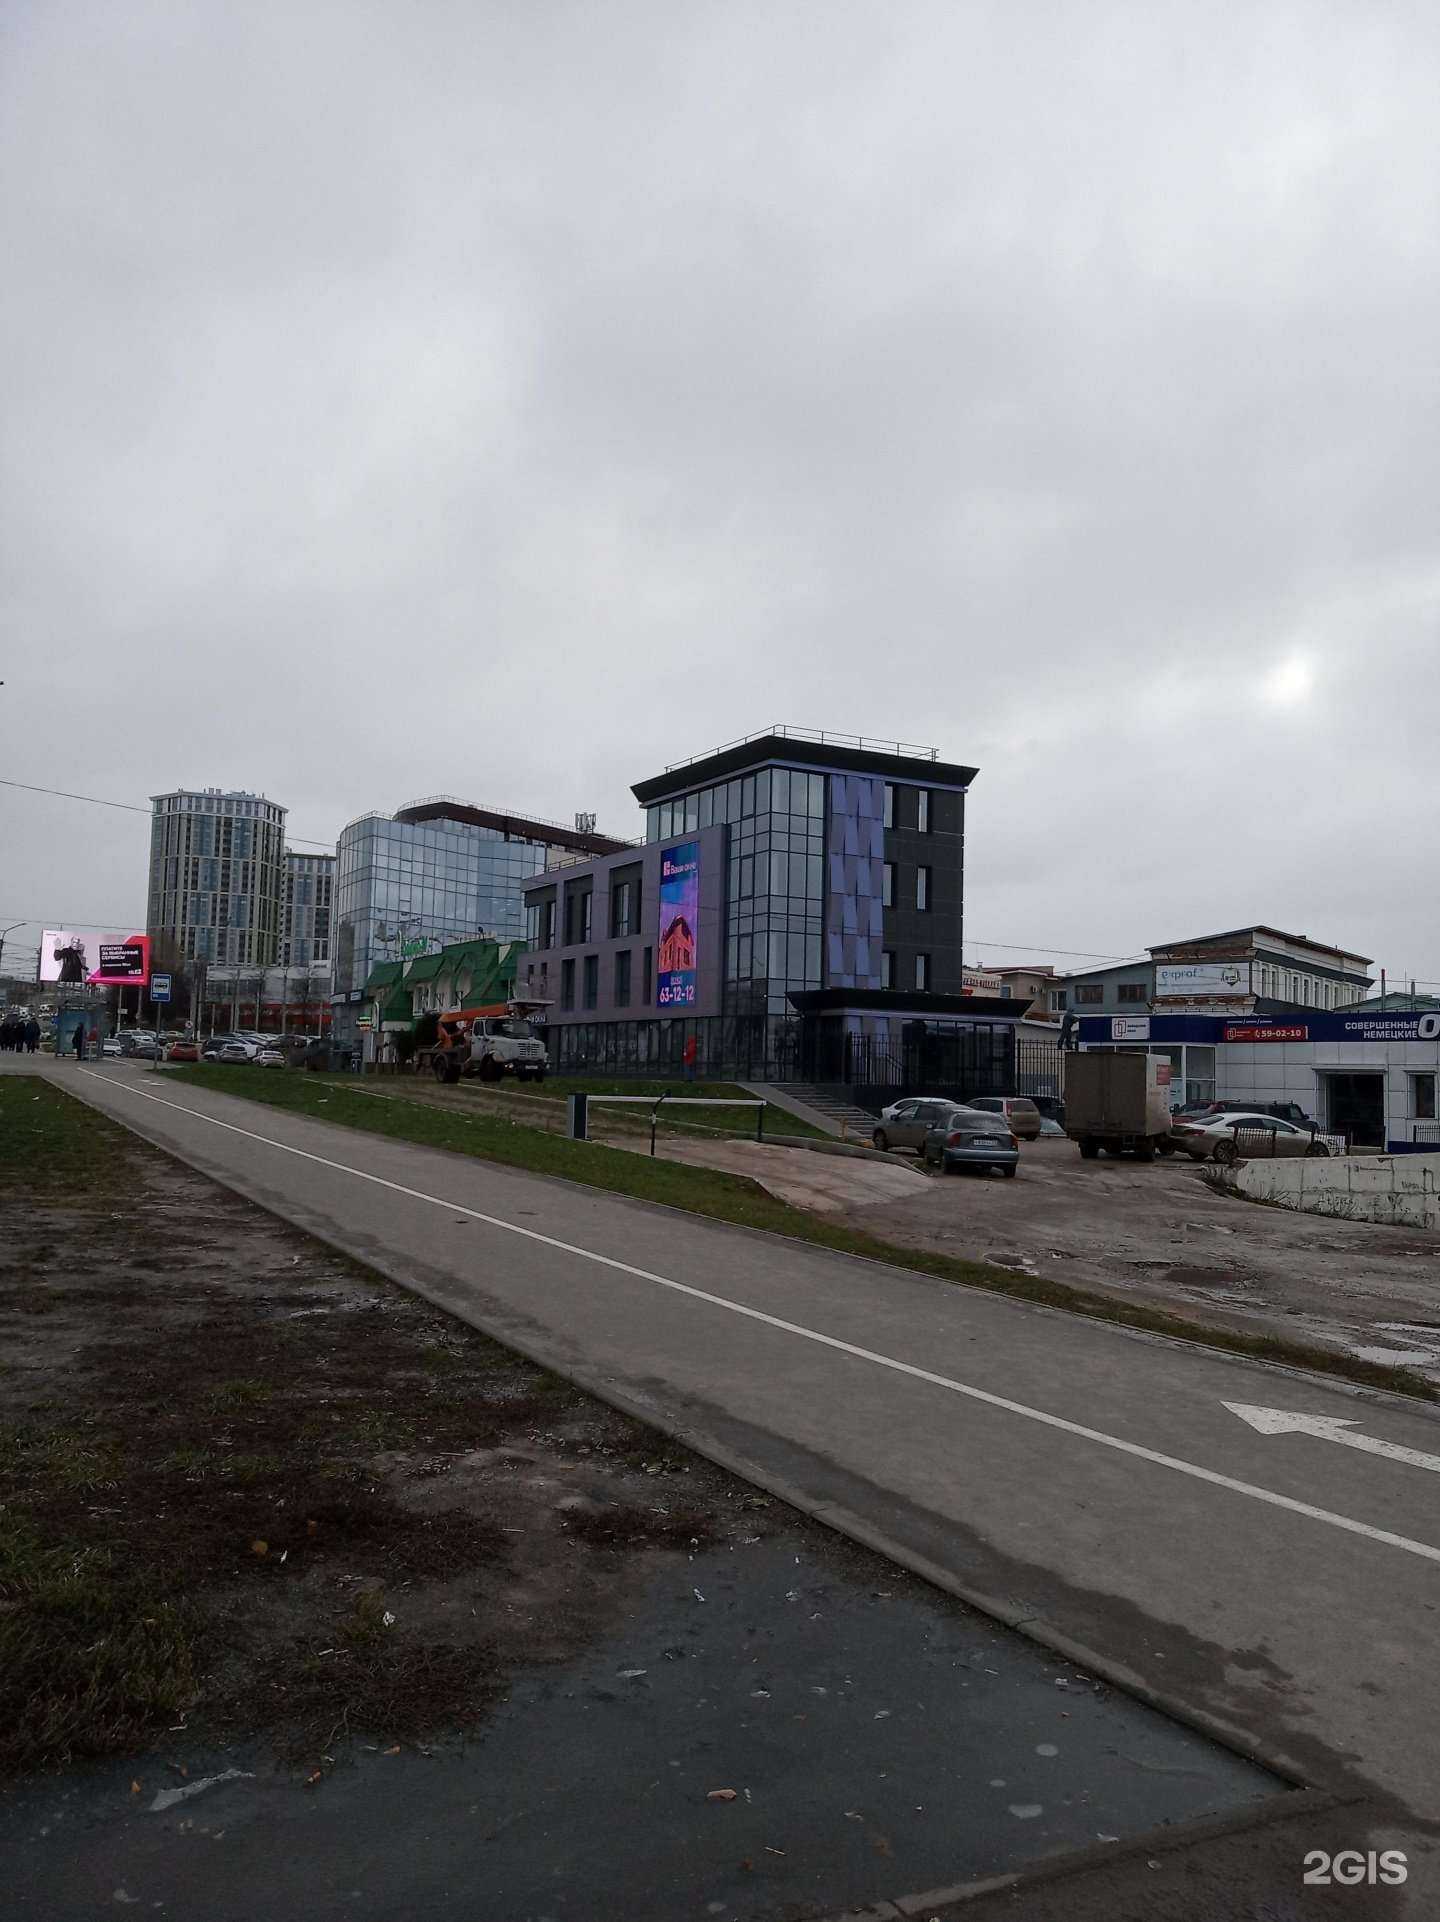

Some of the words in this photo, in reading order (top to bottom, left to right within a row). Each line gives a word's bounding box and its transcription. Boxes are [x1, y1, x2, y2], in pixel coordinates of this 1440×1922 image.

[660, 985, 694, 1003] 63-12-12
[1345, 1021, 1419, 1030] СОВЕРШЕННЫЕ
[1261, 1029, 1302, 1038] 59-02-10
[1363, 1030, 1418, 1040] НЕМЕЦКИЕ
